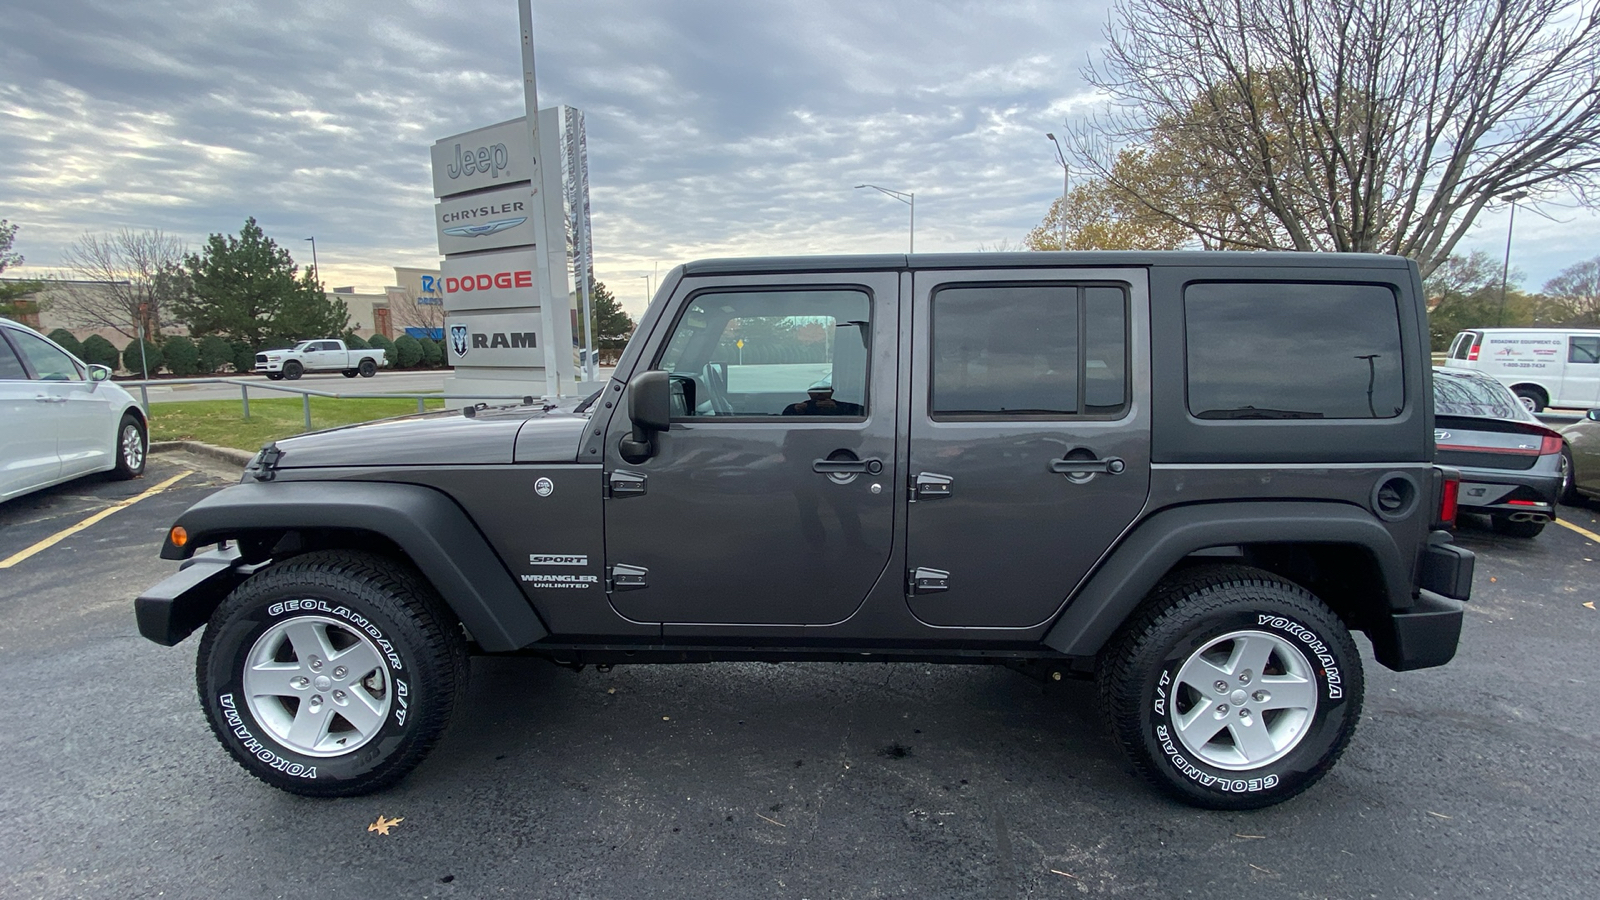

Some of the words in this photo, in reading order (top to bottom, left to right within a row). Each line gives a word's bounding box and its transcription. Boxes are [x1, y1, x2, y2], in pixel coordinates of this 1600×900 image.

[447, 142, 508, 179] Jeep
[442, 201, 524, 223] CHRYSLER
[446, 270, 533, 294] DODGE
[472, 332, 537, 349] RAM
[532, 555, 585, 564] SPORT
[520, 574, 598, 583] WRANGLER
[268, 599, 402, 670] GEOLANDAR
[396, 678, 408, 726] A/T
[1258, 614, 1342, 699] YOKOHAMA
[1154, 670, 1171, 715] A/T
[220, 693, 317, 779] YOKOHAMA
[1156, 724, 1279, 793] GEOLANDAR
